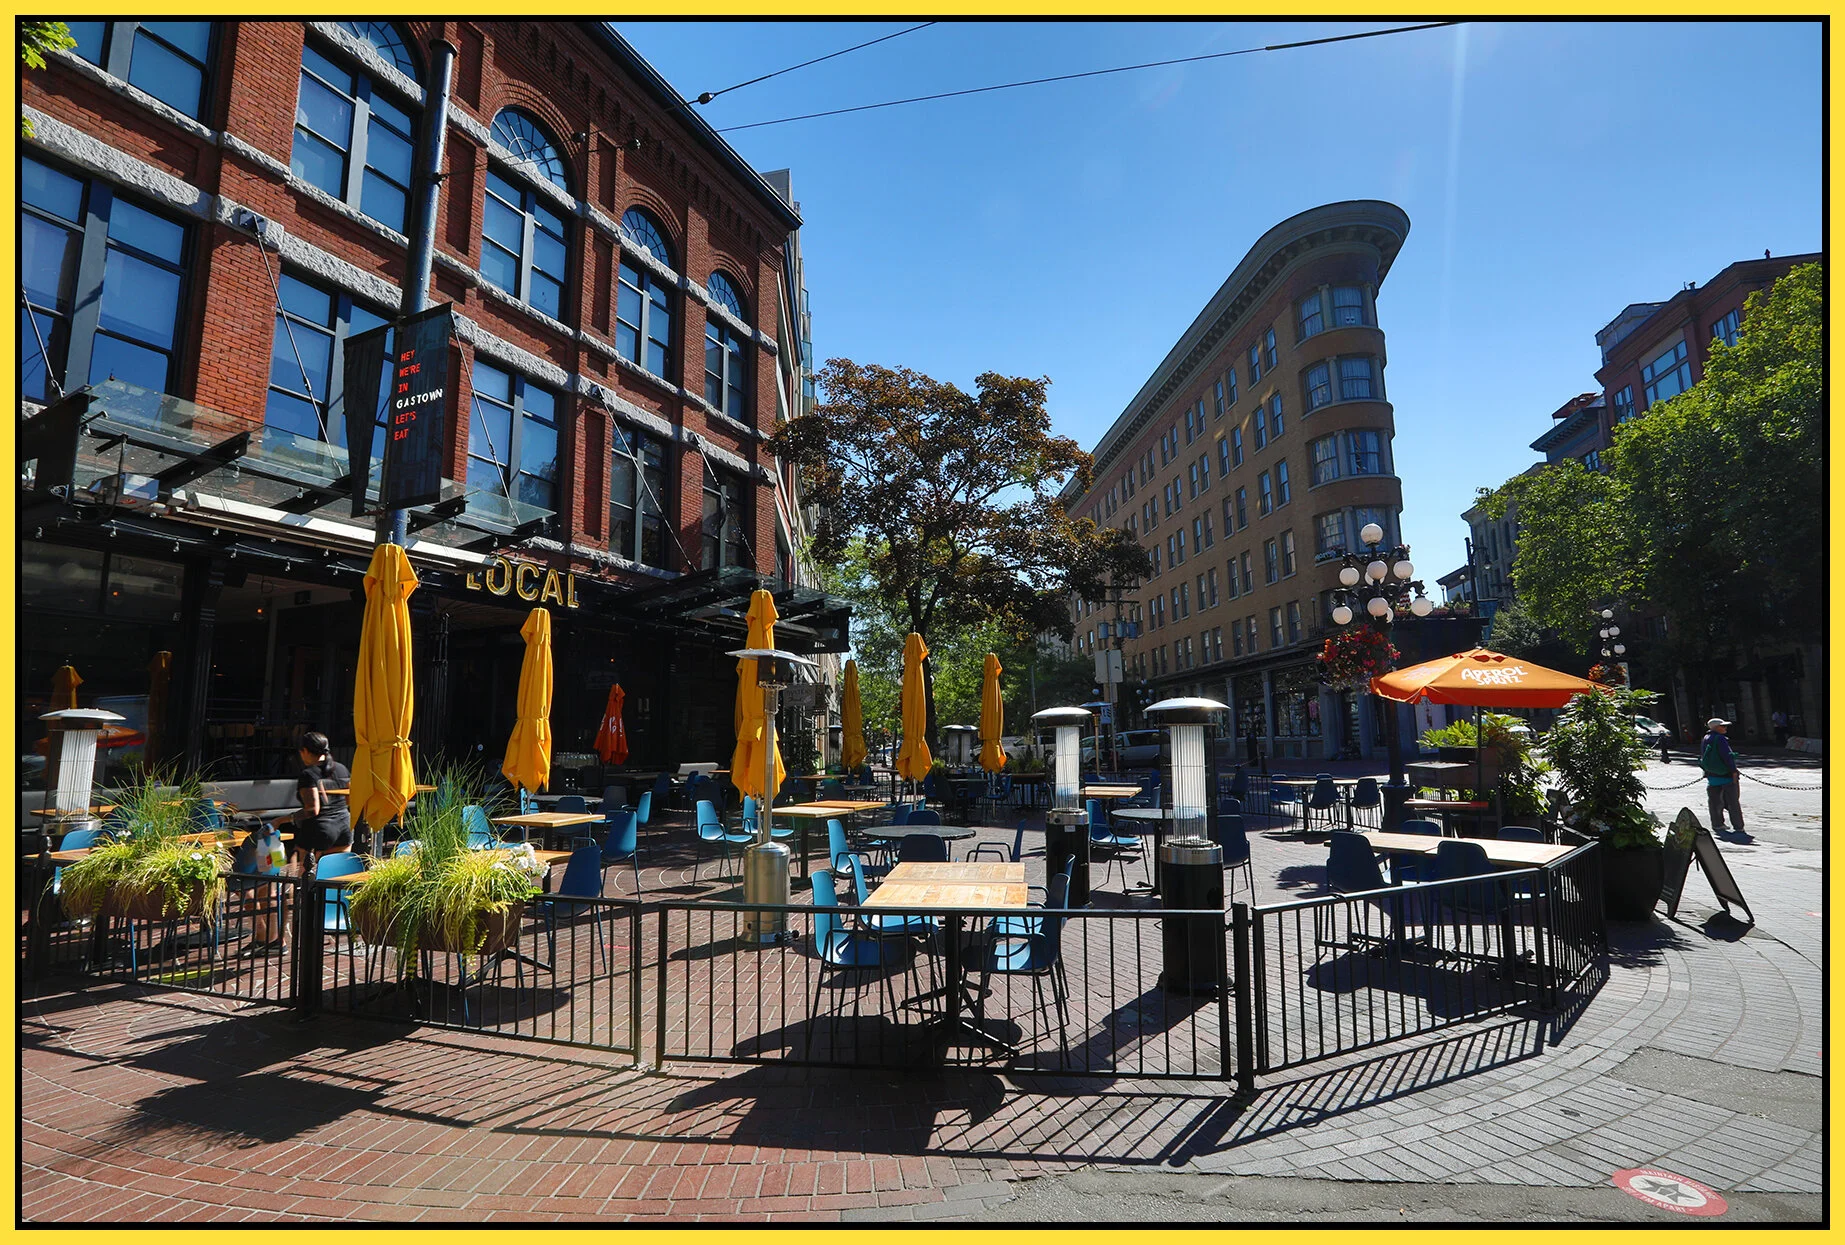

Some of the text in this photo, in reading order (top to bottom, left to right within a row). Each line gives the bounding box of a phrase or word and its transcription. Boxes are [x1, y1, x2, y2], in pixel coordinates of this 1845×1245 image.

[400, 349, 416, 362] HEY
[399, 363, 421, 377] WE'RE
[398, 382, 409, 393] IN
[396, 388, 443, 409] GASTOWN
[395, 411, 417, 425] LET'S
[394, 428, 409, 441] EAT
[1460, 665, 1528, 681] APEROL
[1475, 675, 1523, 686] SPRITZ
